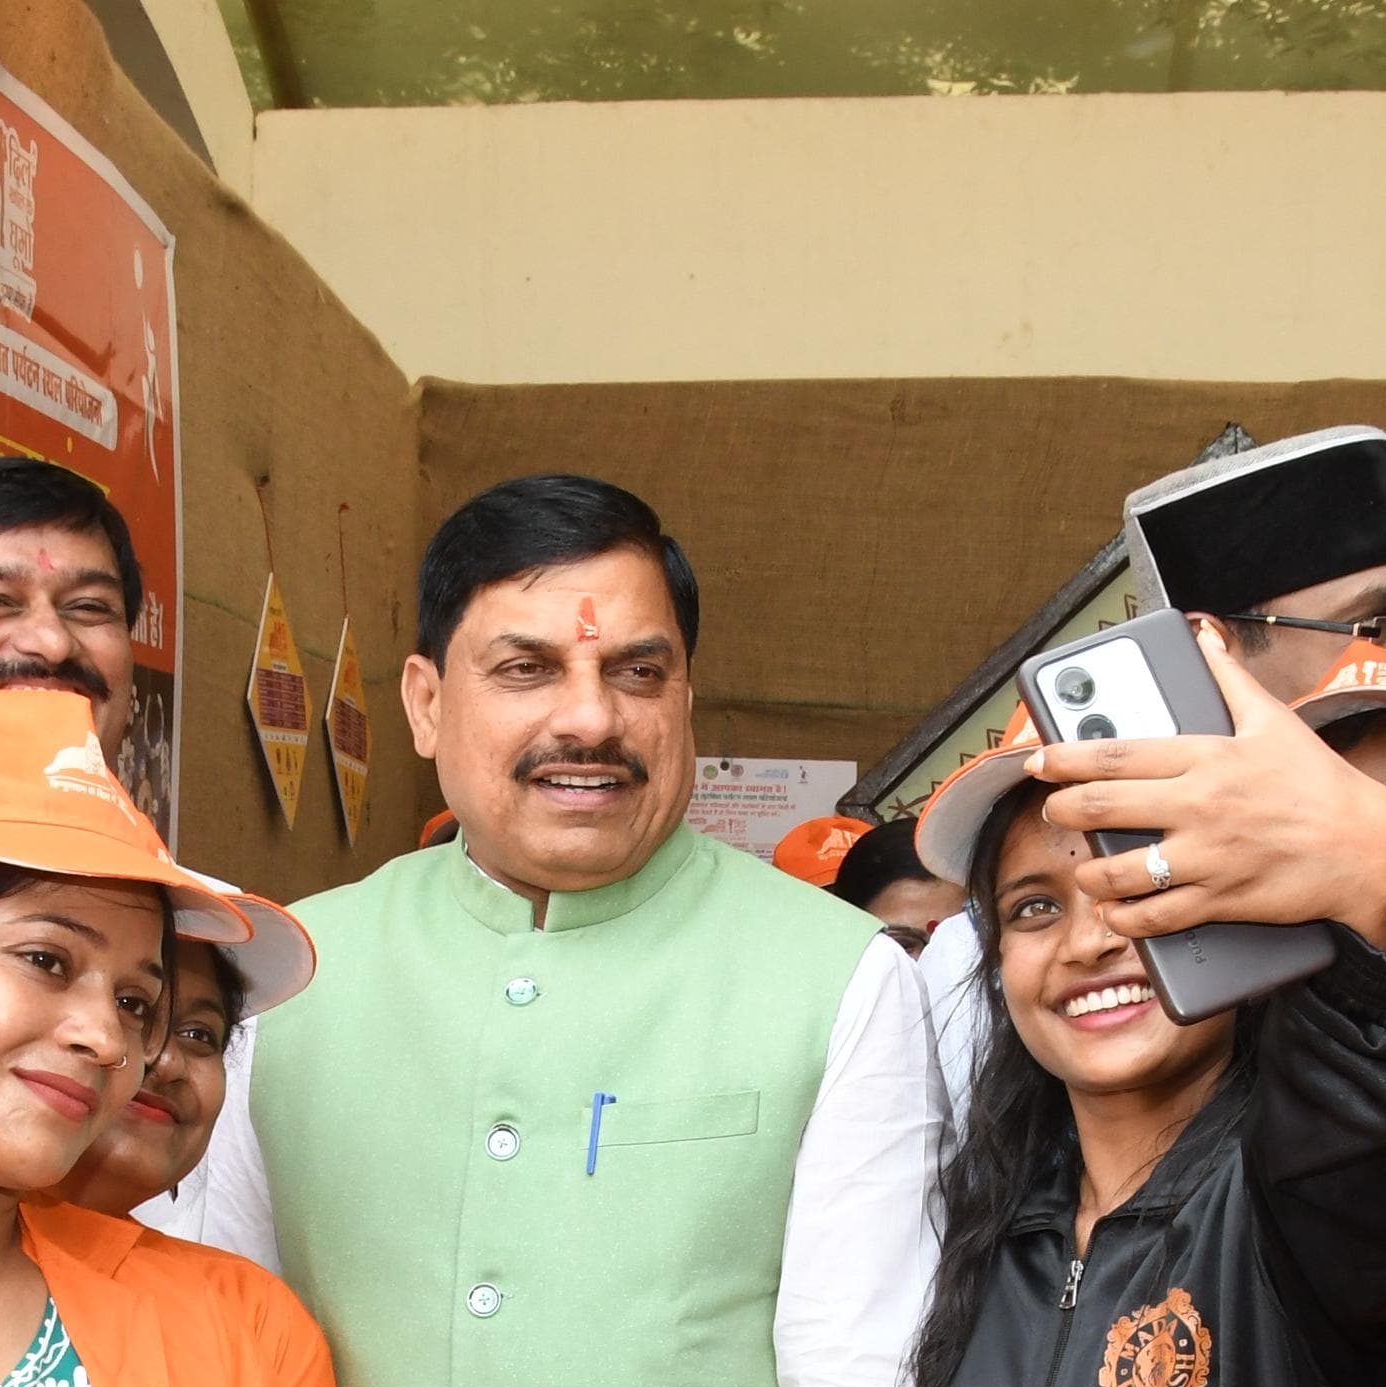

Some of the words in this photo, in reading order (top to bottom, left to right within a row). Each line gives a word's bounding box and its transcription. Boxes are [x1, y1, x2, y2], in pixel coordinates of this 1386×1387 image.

[11, 345, 40, 393] पर्यटन
[42, 366, 64, 405] स्थल
[64, 374, 104, 427] परियोजना
